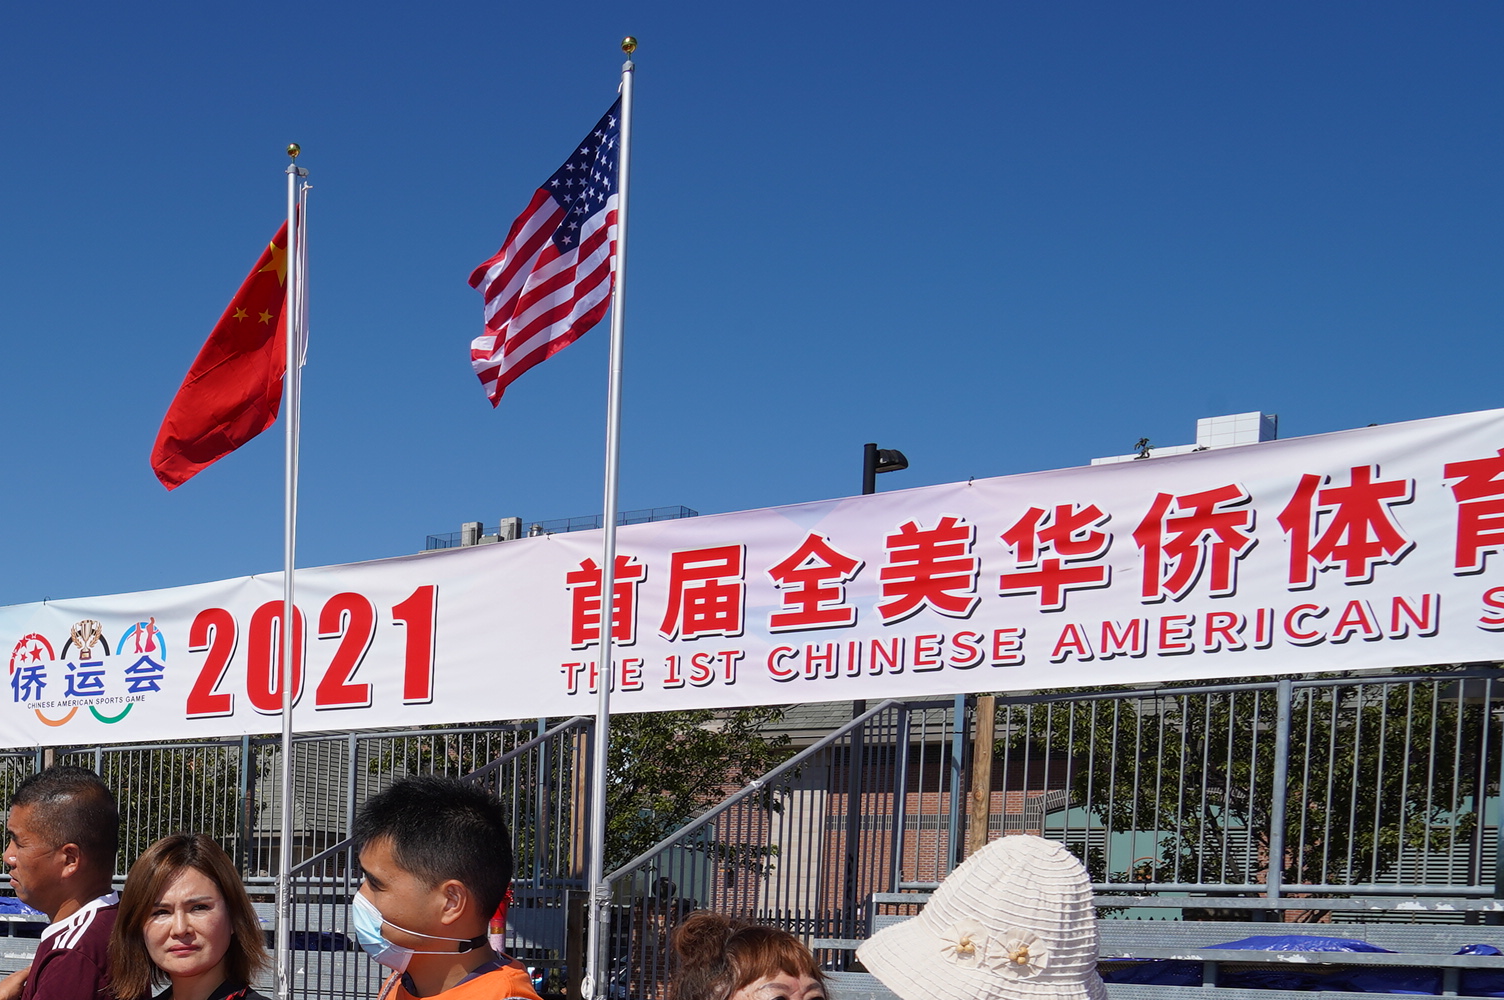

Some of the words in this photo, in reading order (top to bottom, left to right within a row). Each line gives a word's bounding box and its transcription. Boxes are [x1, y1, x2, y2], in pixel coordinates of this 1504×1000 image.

[11, 655, 165, 702] 侨运会
[186, 585, 437, 718] 2021
[561, 658, 642, 693] THE
[664, 650, 744, 688] 1ST
[767, 628, 1024, 681] CHINESE
[1052, 593, 1439, 662] AMERICAN
[28, 701, 55, 709] CHINESE
[57, 698, 94, 708] AMERICAN
[96, 696, 124, 705] SPORTS
